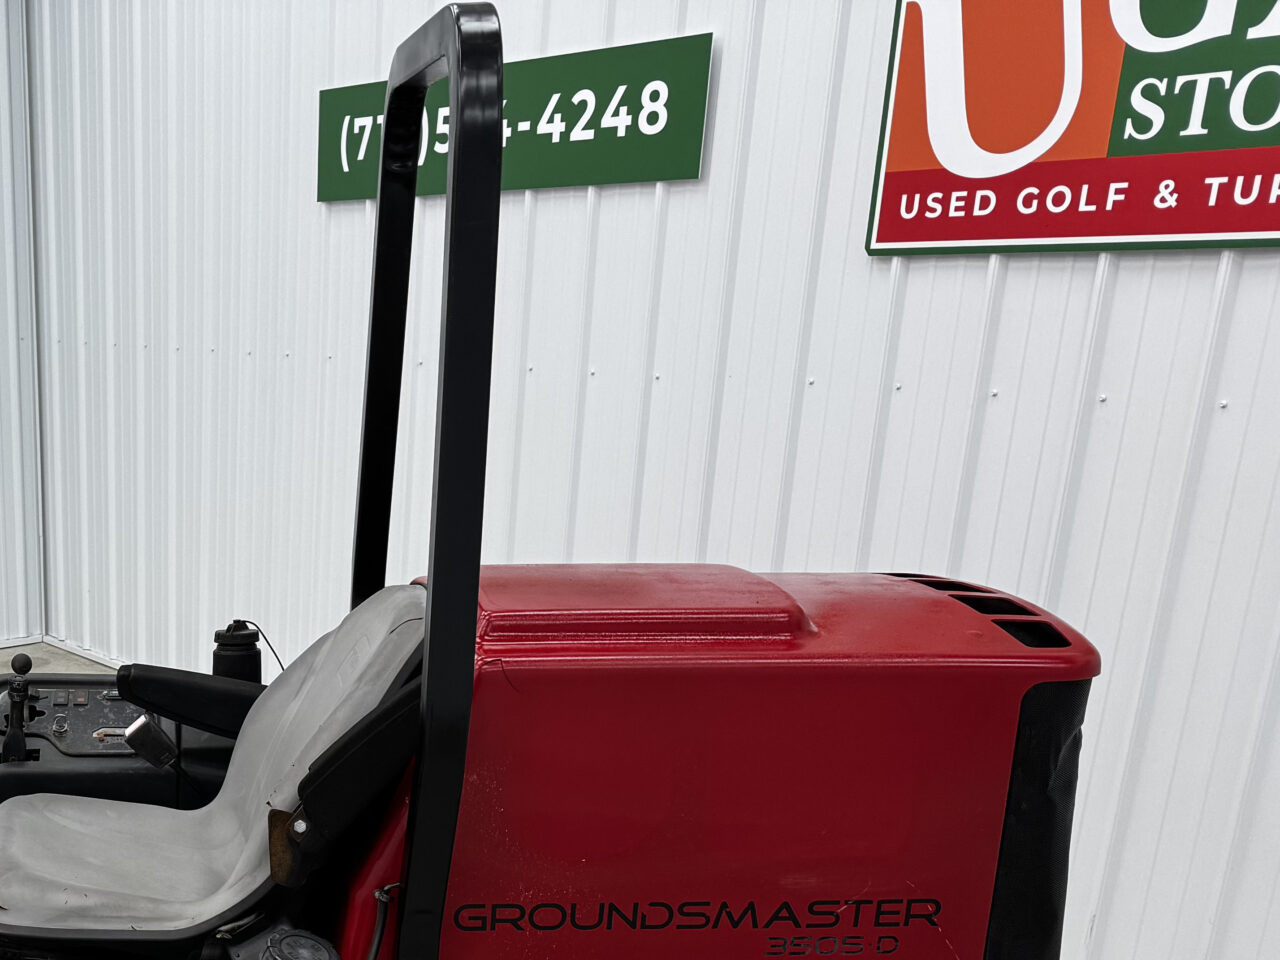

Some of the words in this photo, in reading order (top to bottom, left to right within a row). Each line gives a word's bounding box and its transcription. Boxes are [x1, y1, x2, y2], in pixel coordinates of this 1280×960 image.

[900, 189, 997, 219] USED
[1017, 182, 1129, 214] GOLF
[1153, 179, 1179, 209] &
[453, 898, 942, 931] GROUNDSMASTER
